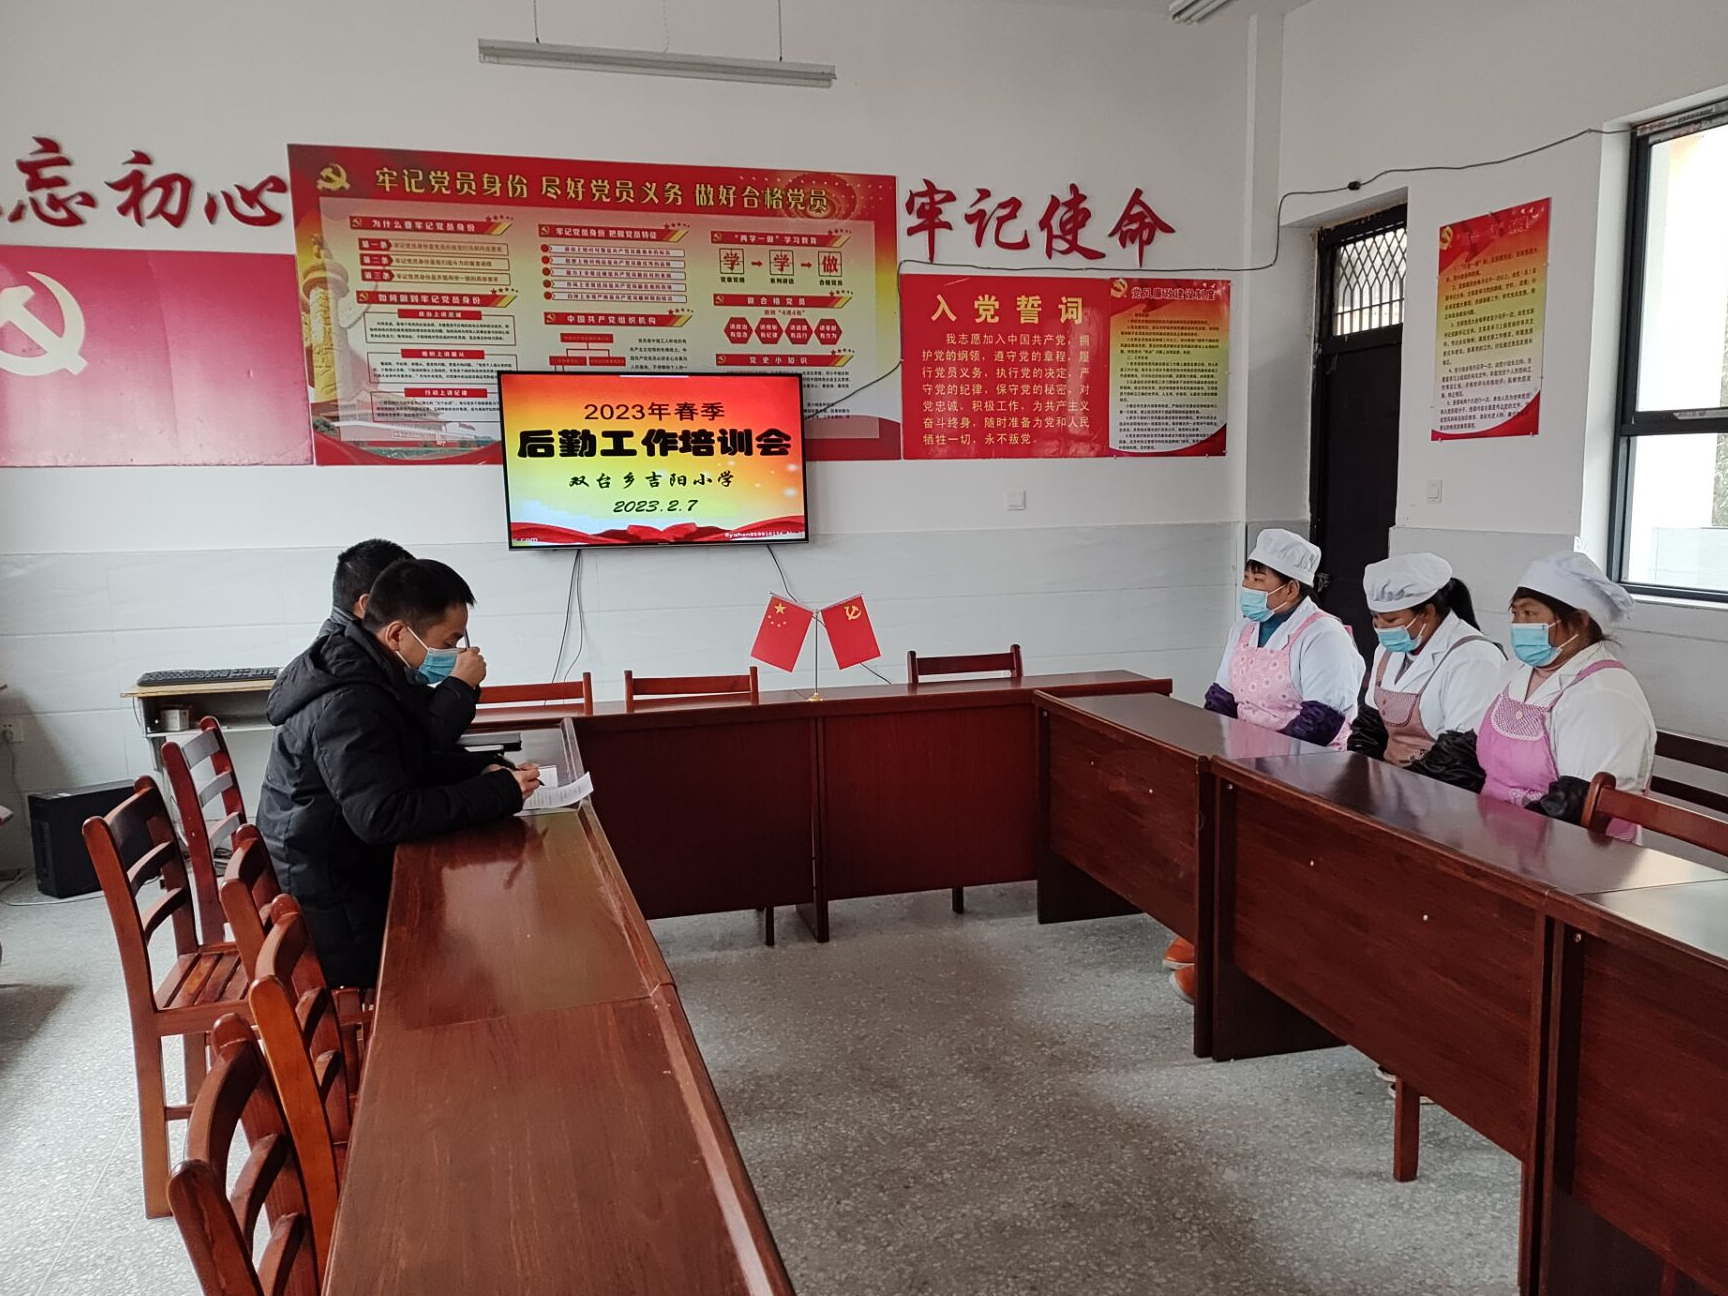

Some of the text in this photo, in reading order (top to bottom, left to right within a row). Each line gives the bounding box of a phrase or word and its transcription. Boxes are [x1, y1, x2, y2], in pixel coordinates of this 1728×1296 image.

[0, 137, 288, 228] 忘初心
[375, 167, 829, 212] 牢记党员身份 尽好党员义务 做好合格党员
[372, 219, 476, 232] 为什么要牢记党员身份
[905, 178, 1176, 268] 牢记使命
[556, 227, 606, 238] 牢记党员身份
[723, 252, 740, 271] 学
[773, 254, 790, 273] 学
[821, 255, 838, 274] 做
[930, 293, 1084, 325] 入党誓词
[567, 315, 657, 325] 中国共产党组织机构
[945, 333, 1090, 347] 我志愿加入中国共产党，拥
[922, 349, 1090, 363] 护党的纲领，遵守党的章程，履
[922, 366, 1090, 379] 行党员义务，执行党的决定，严
[922, 383, 1090, 396] 守党的纪律，保守党的秘密，对
[584, 401, 725, 422] 2023年春季
[922, 400, 1090, 412] 党忠诚，积极工作，为共产主义
[923, 416, 1090, 429] 奋斗终身，随时准备为党和人民
[516, 427, 792, 459] 后勤工作培训会
[923, 433, 1037, 446] 牺牲一切，永不叛党。
[568, 470, 735, 490] 双台乡吉阳小学
[612, 498, 699, 514] 2023.2.7
